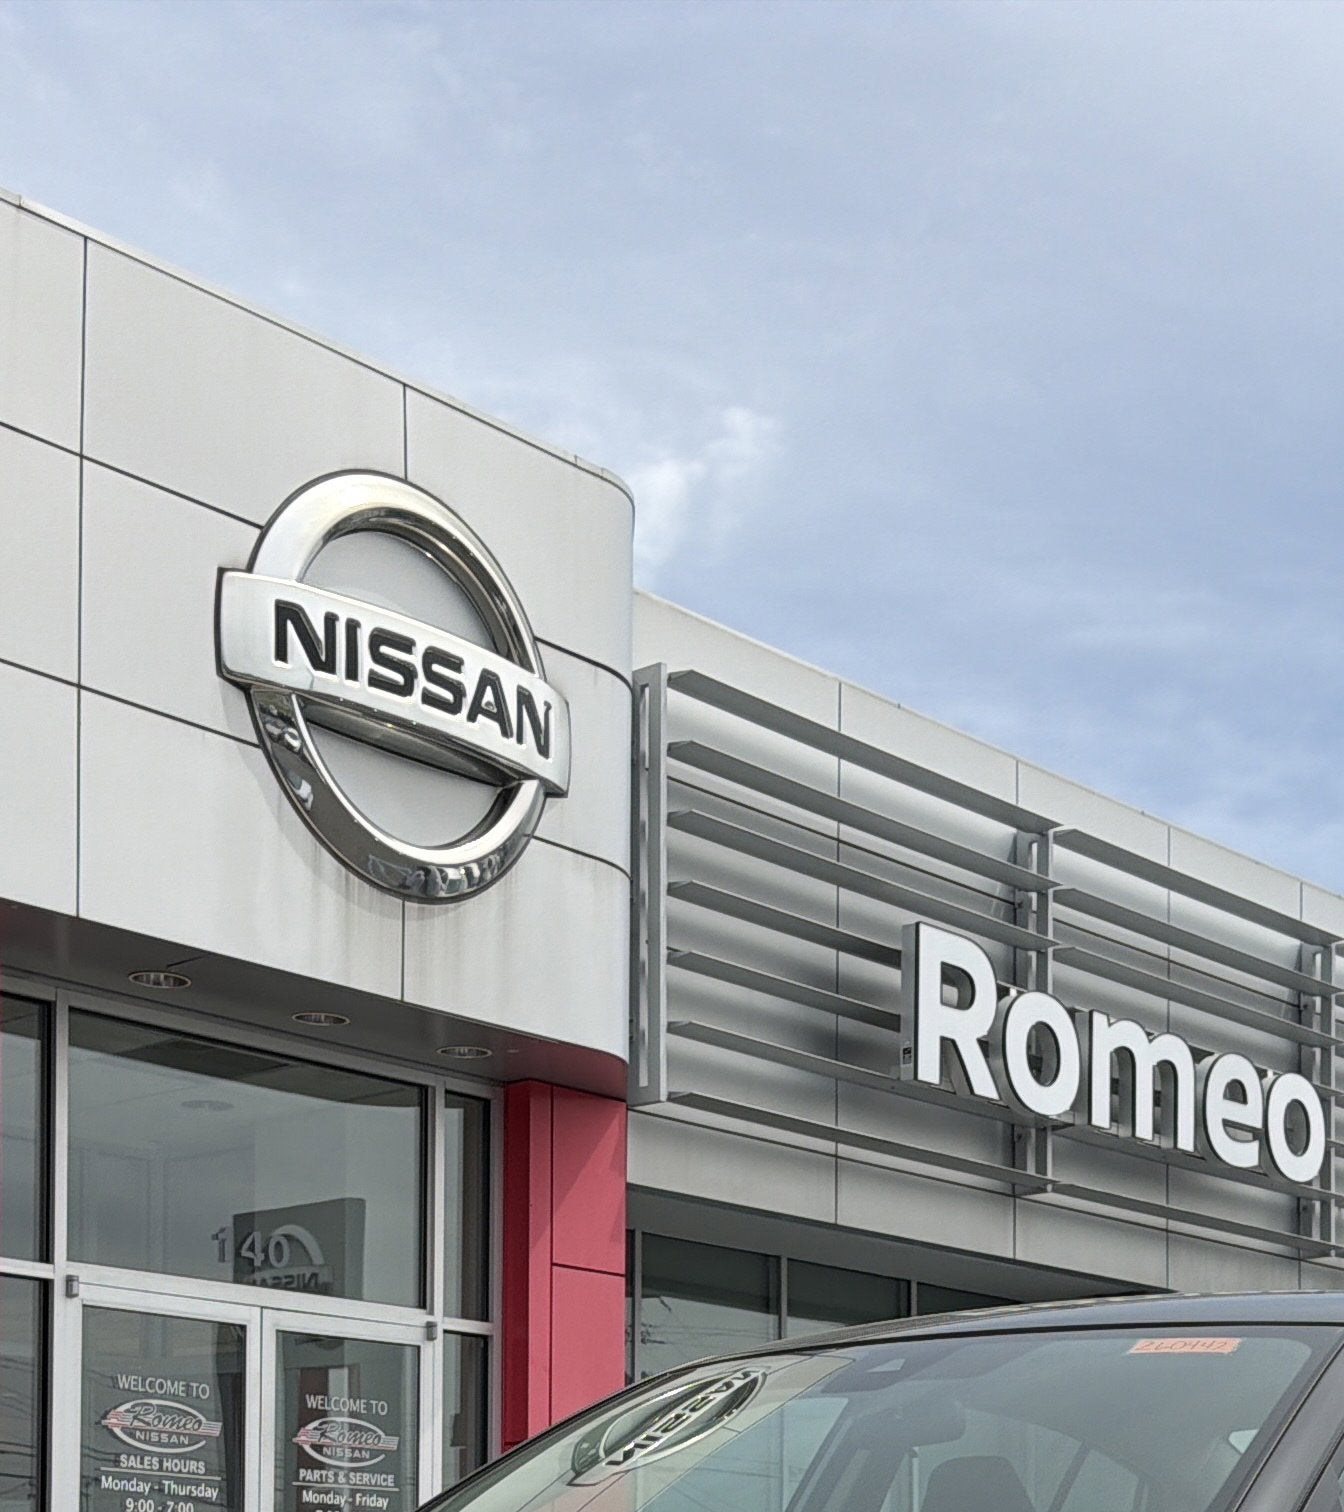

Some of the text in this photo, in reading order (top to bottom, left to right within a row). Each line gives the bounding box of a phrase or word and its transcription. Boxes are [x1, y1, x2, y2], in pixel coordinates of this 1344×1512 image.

[274, 598, 552, 760] NISSAN
[912, 920, 1326, 1184] Romeo
[116, 1374, 210, 1399] WELCOME TO
[305, 1394, 388, 1416] WELCOME TO
[125, 1402, 204, 1431] Romeo
[135, 1430, 189, 1445] NISSAN
[314, 1420, 383, 1446] Romeo
[322, 1446, 370, 1459] NISSAN
[119, 1454, 206, 1474] SALES HOURS
[100, 1475, 151, 1496] Monday
[162, 1480, 219, 1501] Thursday
[299, 1468, 395, 1487] PARTS & SERVICE
[125, 1498, 154, 1512] 9:00
[302, 1489, 347, 1508] Monday
[356, 1493, 389, 1510] Friday
